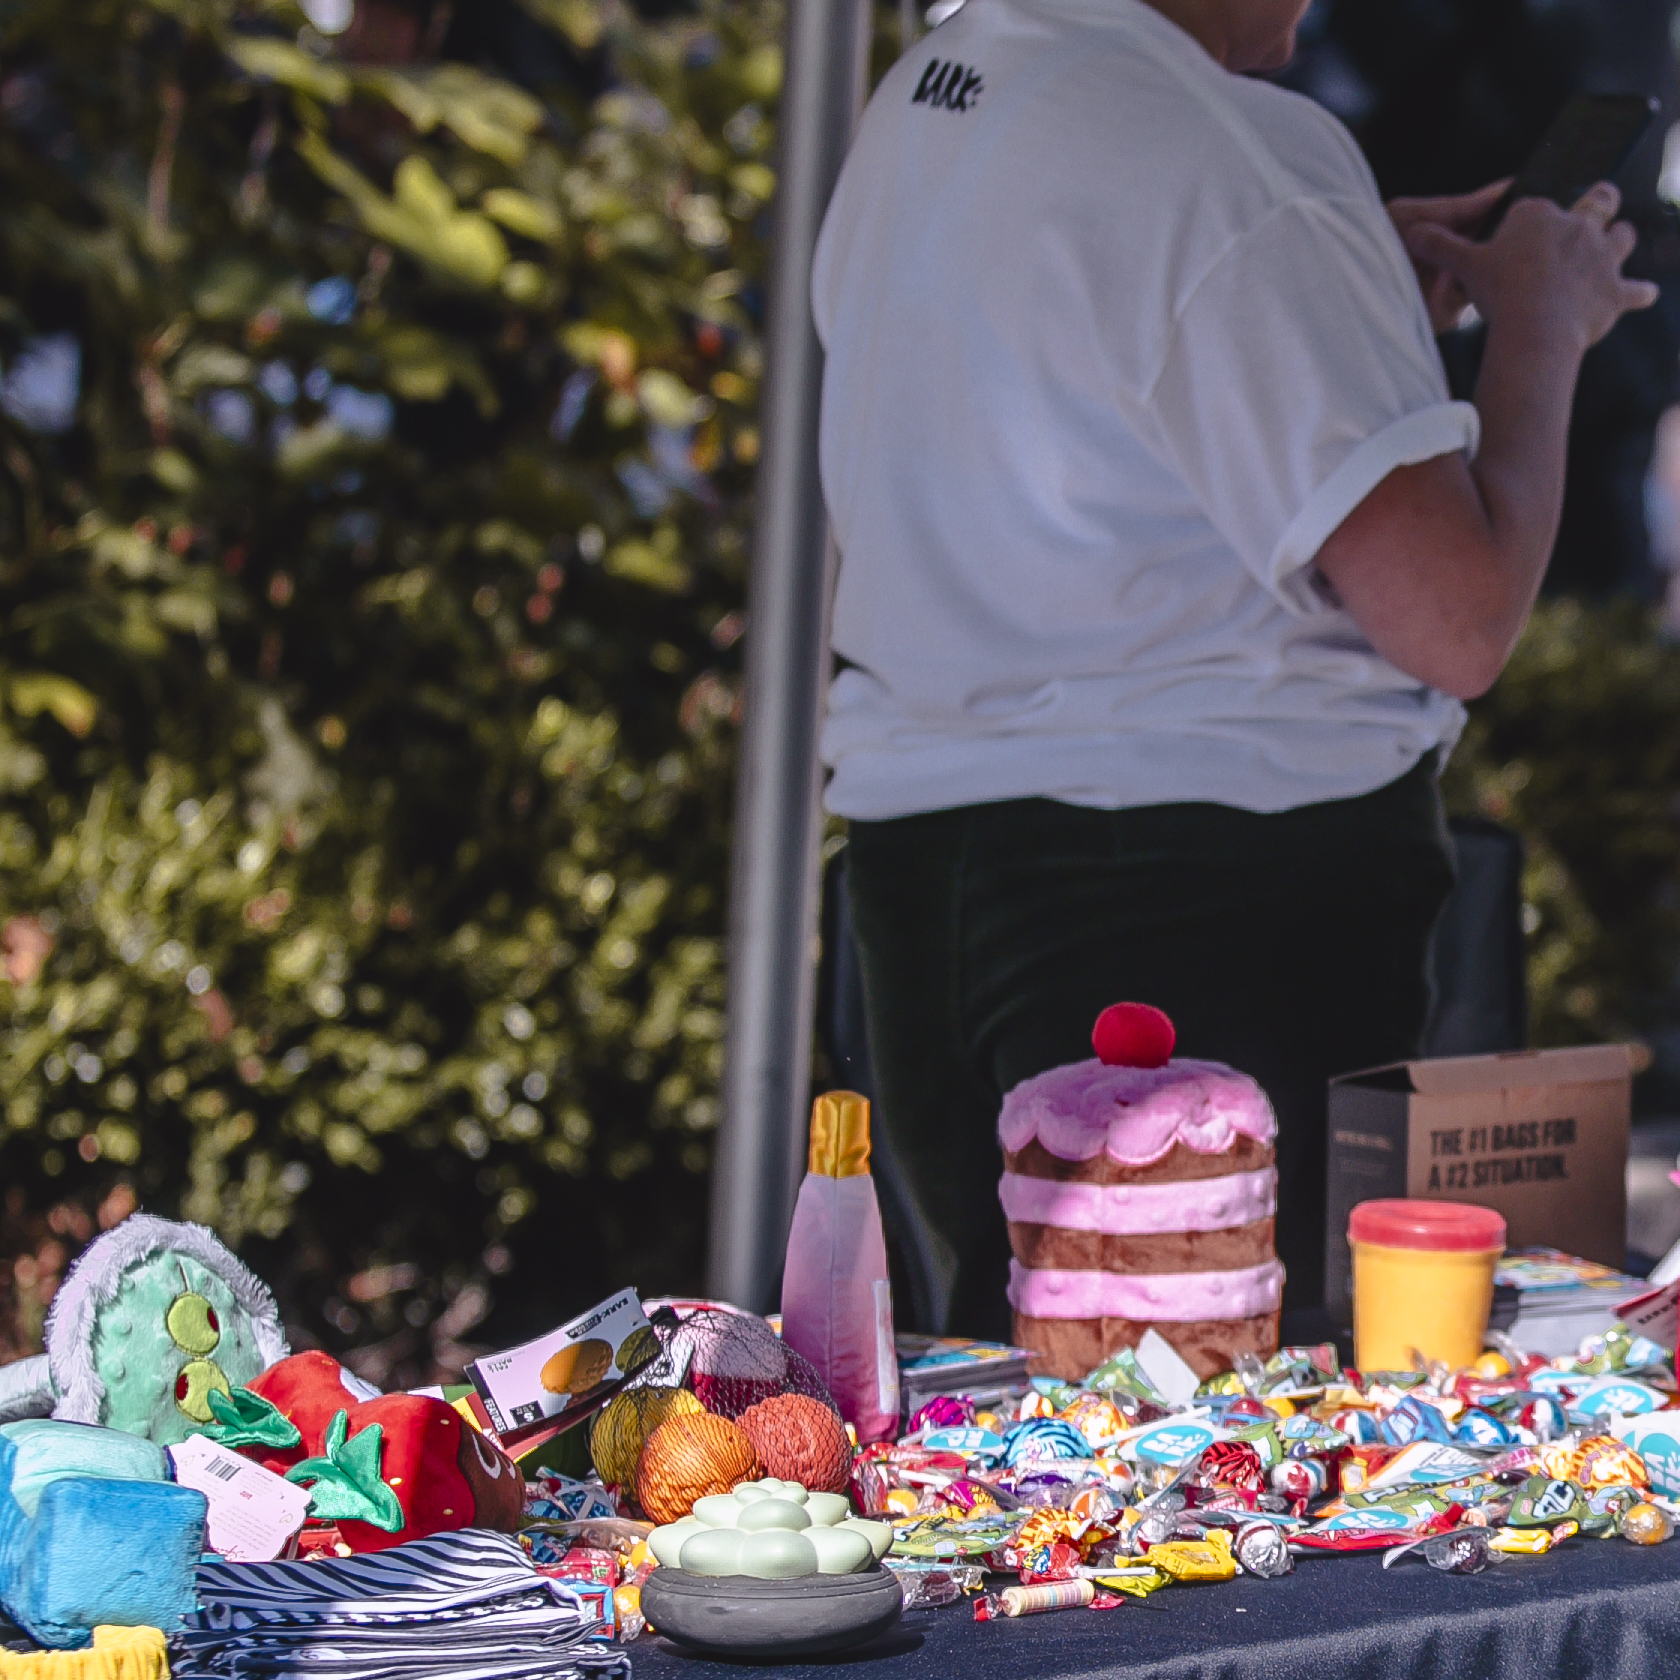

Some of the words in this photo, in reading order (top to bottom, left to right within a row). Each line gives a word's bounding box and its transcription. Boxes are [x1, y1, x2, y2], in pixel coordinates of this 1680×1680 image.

[1431, 1128, 1463, 1156] THE
[1470, 1126, 1488, 1153] #1
[1491, 1121, 1539, 1152] BAGS
[1543, 1118, 1578, 1148] FOR
[1428, 1163, 1441, 1192] A
[1446, 1161, 1468, 1189] #2
